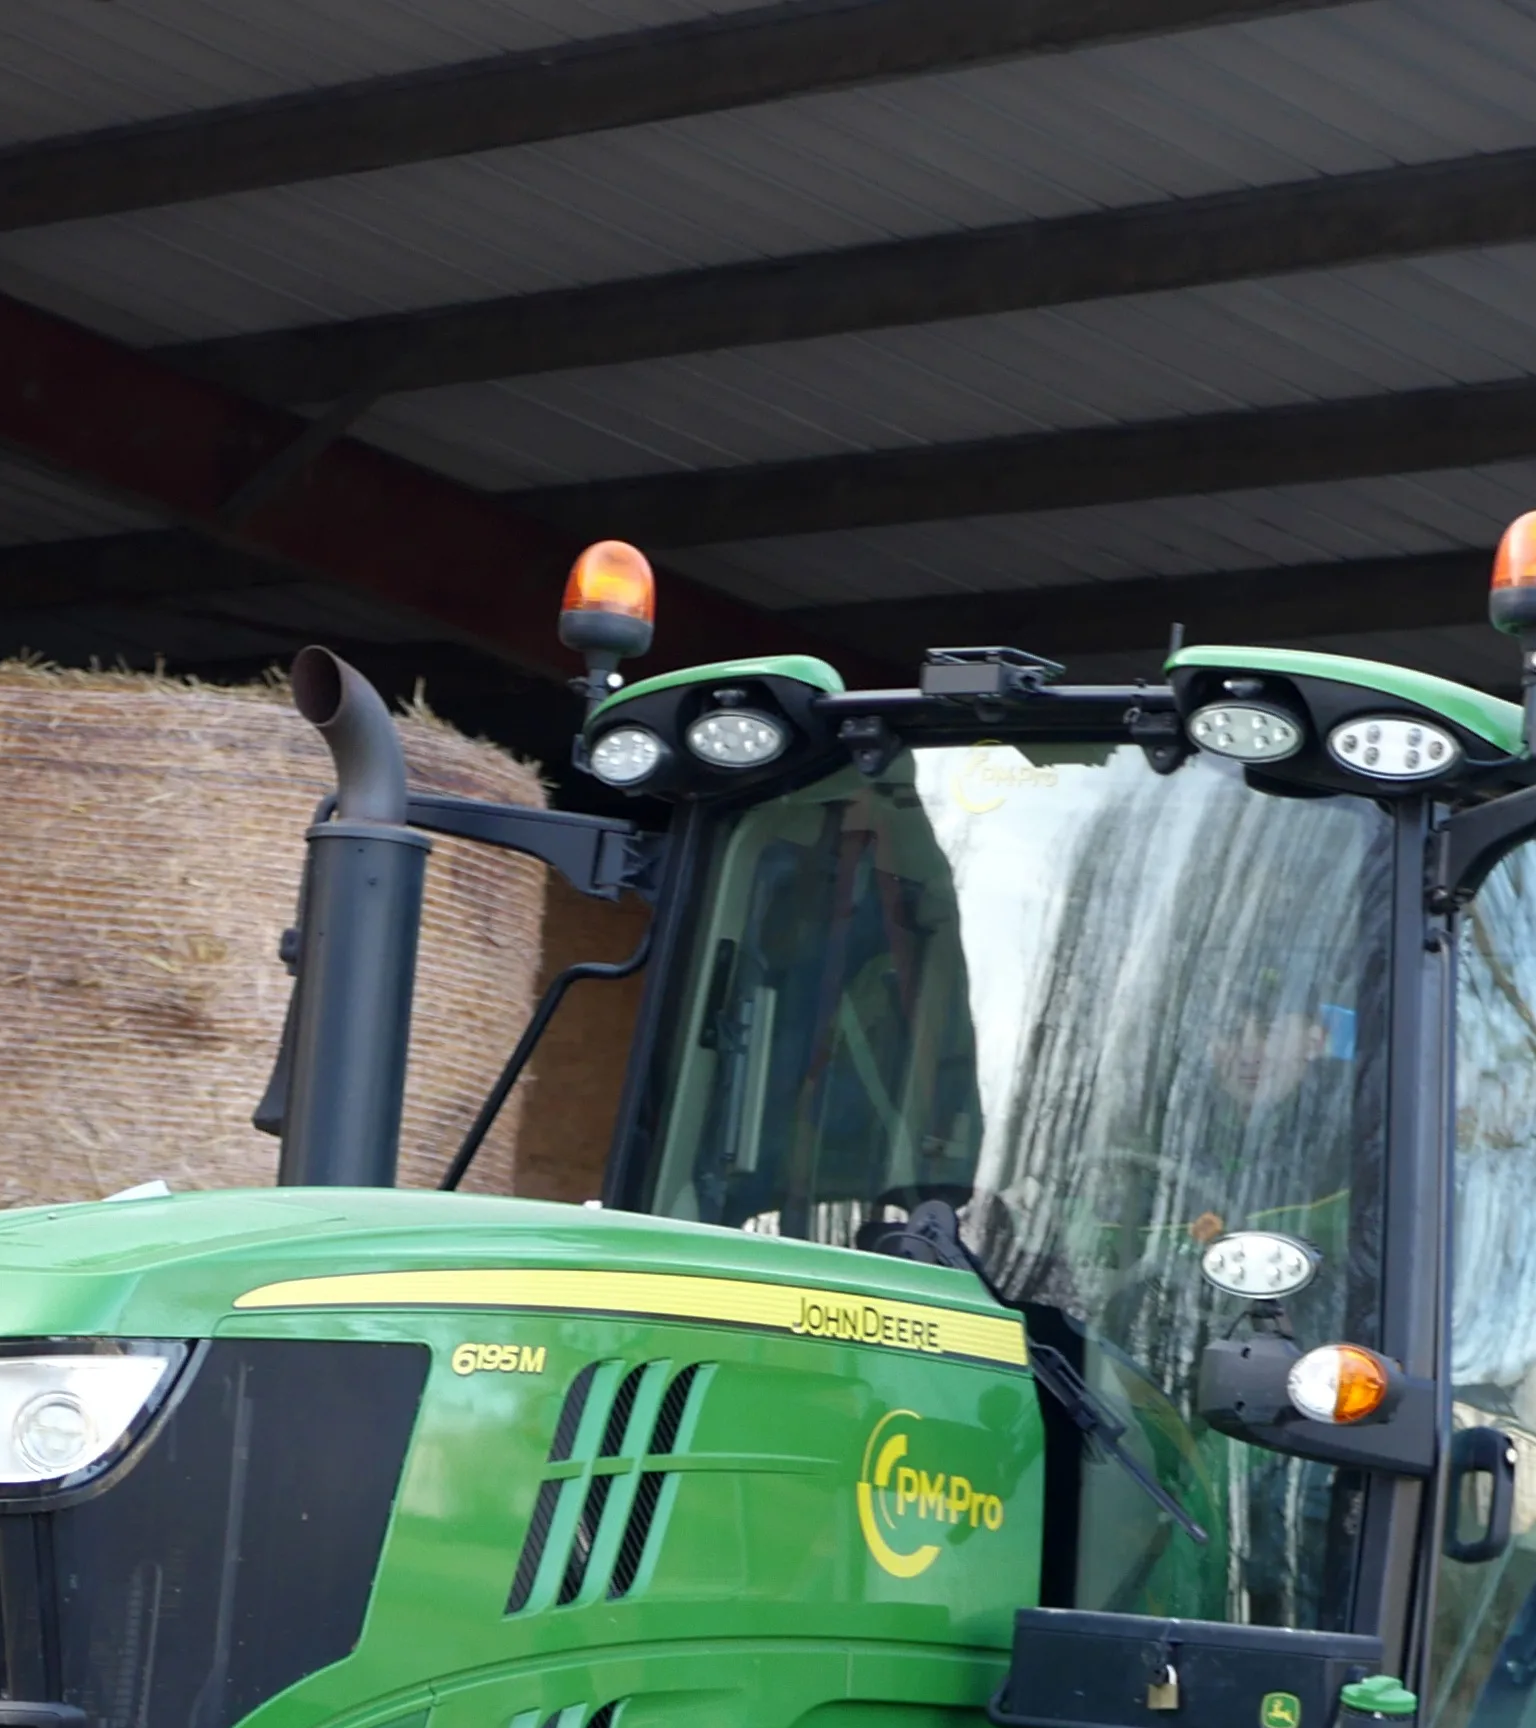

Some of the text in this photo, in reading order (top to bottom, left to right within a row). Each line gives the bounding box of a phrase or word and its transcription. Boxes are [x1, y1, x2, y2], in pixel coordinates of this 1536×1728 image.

[792, 1297, 940, 1348] JOHN DEERE
[451, 1343, 547, 1376] 6195M
